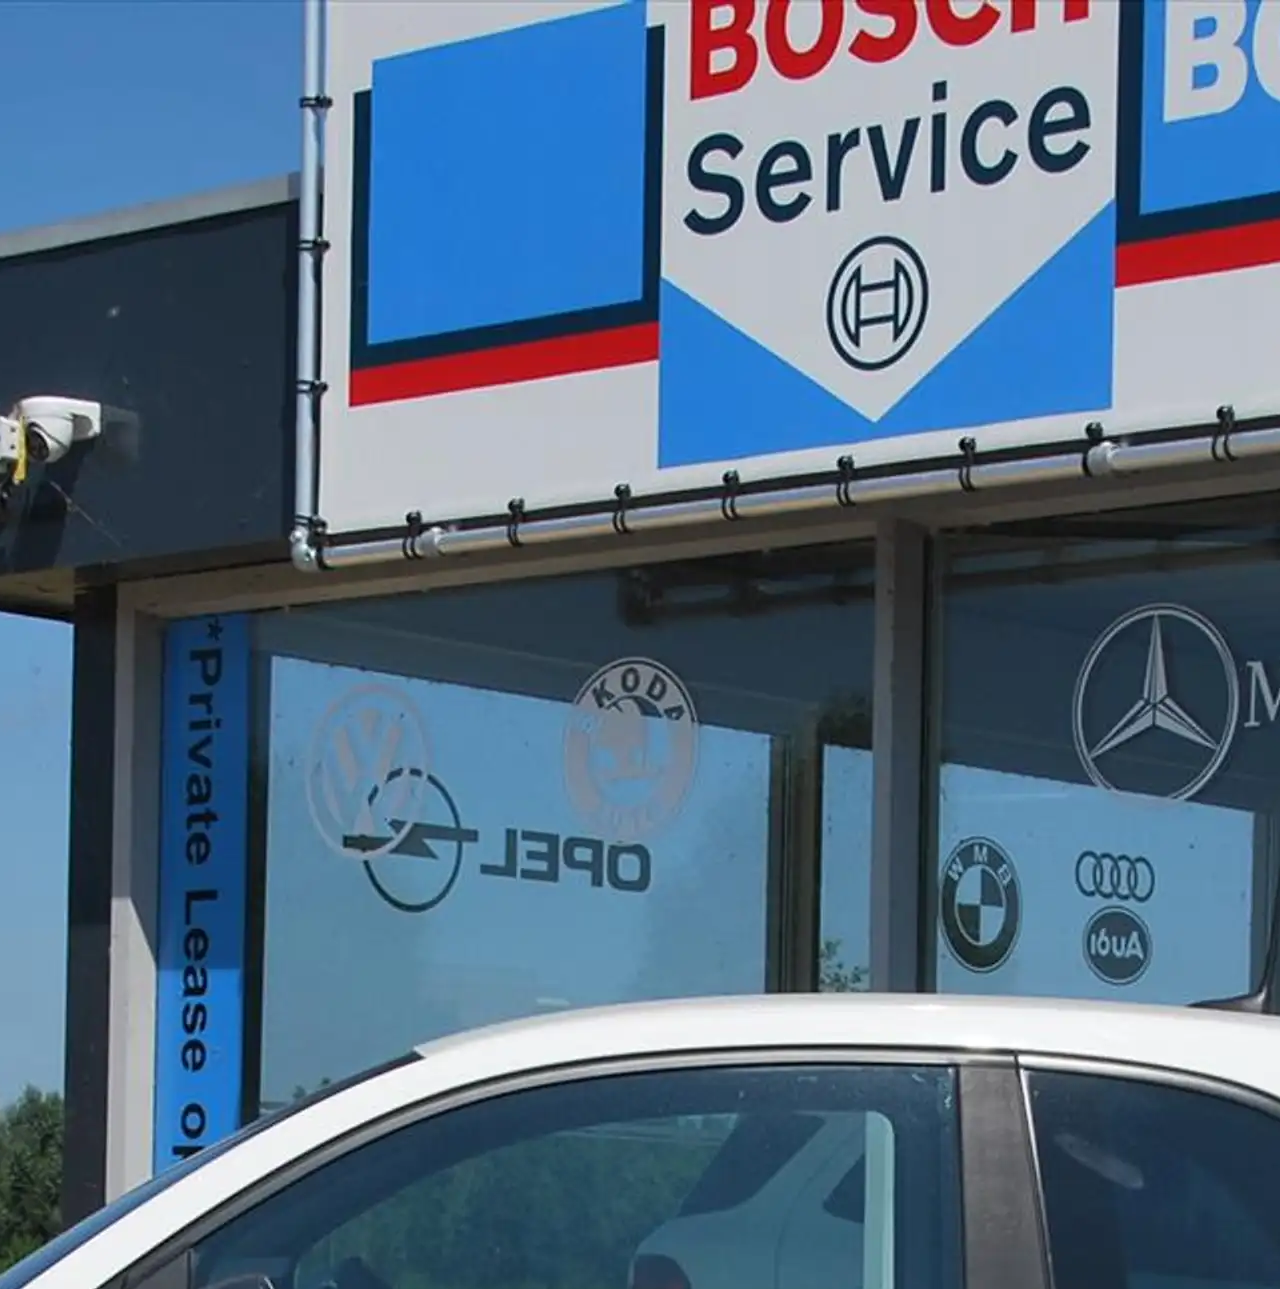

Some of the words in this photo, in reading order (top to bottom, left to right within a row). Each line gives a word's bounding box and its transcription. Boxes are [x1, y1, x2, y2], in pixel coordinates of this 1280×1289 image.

[690, 0, 1089, 101] BOS
[683, 80, 1091, 236] Service
[592, 666, 686, 721] KODA
[181, 889, 218, 1072] Lease
